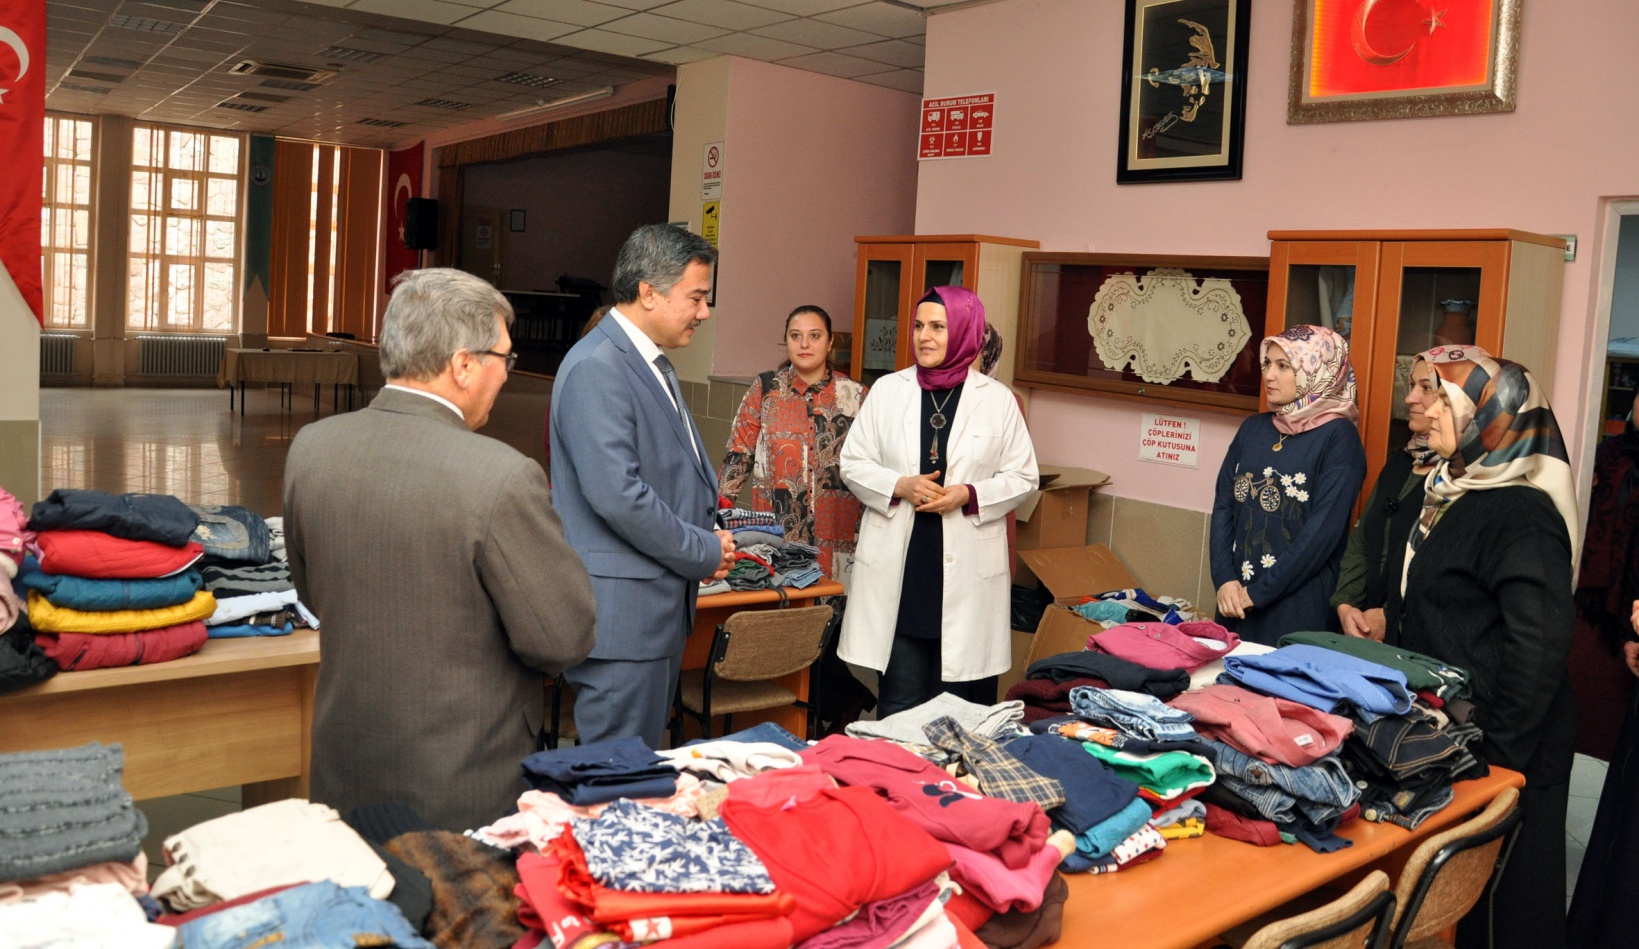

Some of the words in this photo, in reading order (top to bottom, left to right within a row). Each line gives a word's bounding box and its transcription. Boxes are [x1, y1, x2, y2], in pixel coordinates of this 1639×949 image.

[1154, 418, 1182, 428] LÜTFEN
[1148, 428, 1192, 440] ÇÖPLERİNİZİ
[1142, 438, 1156, 447] ÇÖP
[1158, 441, 1196, 452] KUTUSUNA
[1156, 452, 1180, 461] ATINIZ
